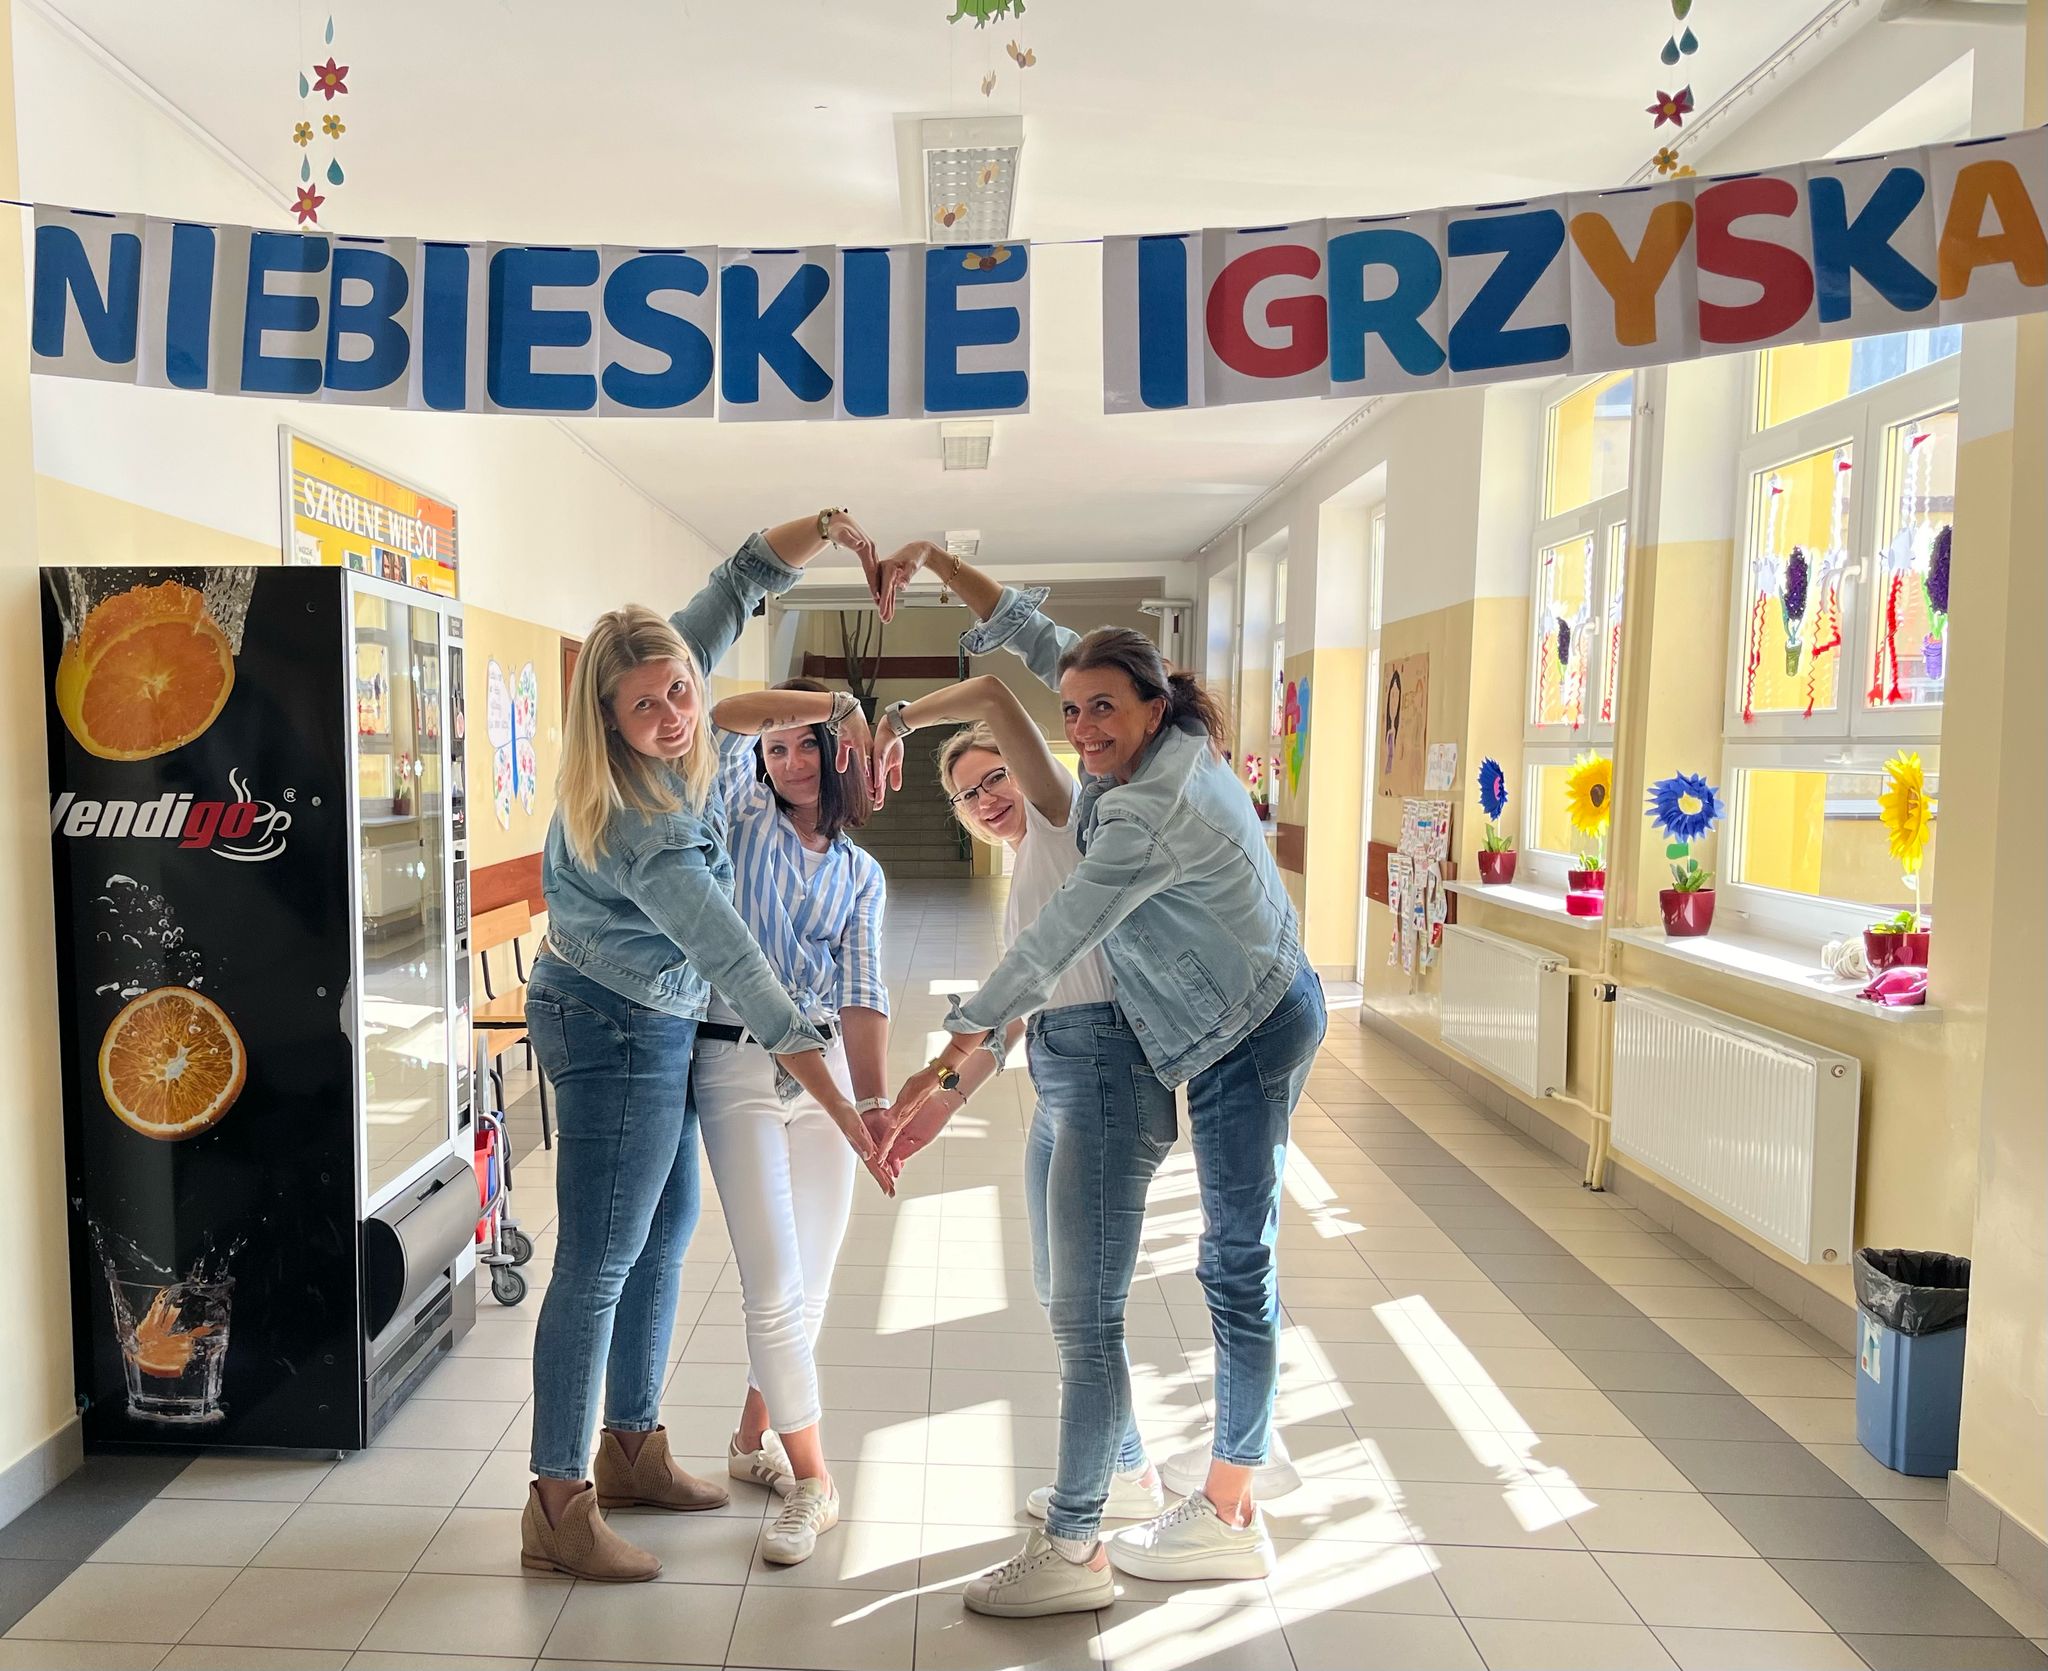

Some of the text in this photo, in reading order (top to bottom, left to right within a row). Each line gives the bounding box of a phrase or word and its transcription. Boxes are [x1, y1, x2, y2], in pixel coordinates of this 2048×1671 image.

[32, 160, 2048, 417] NIEBIESKIE IGRZYSKA
[305, 478, 437, 560] SZKOLNE WIEŚCI
